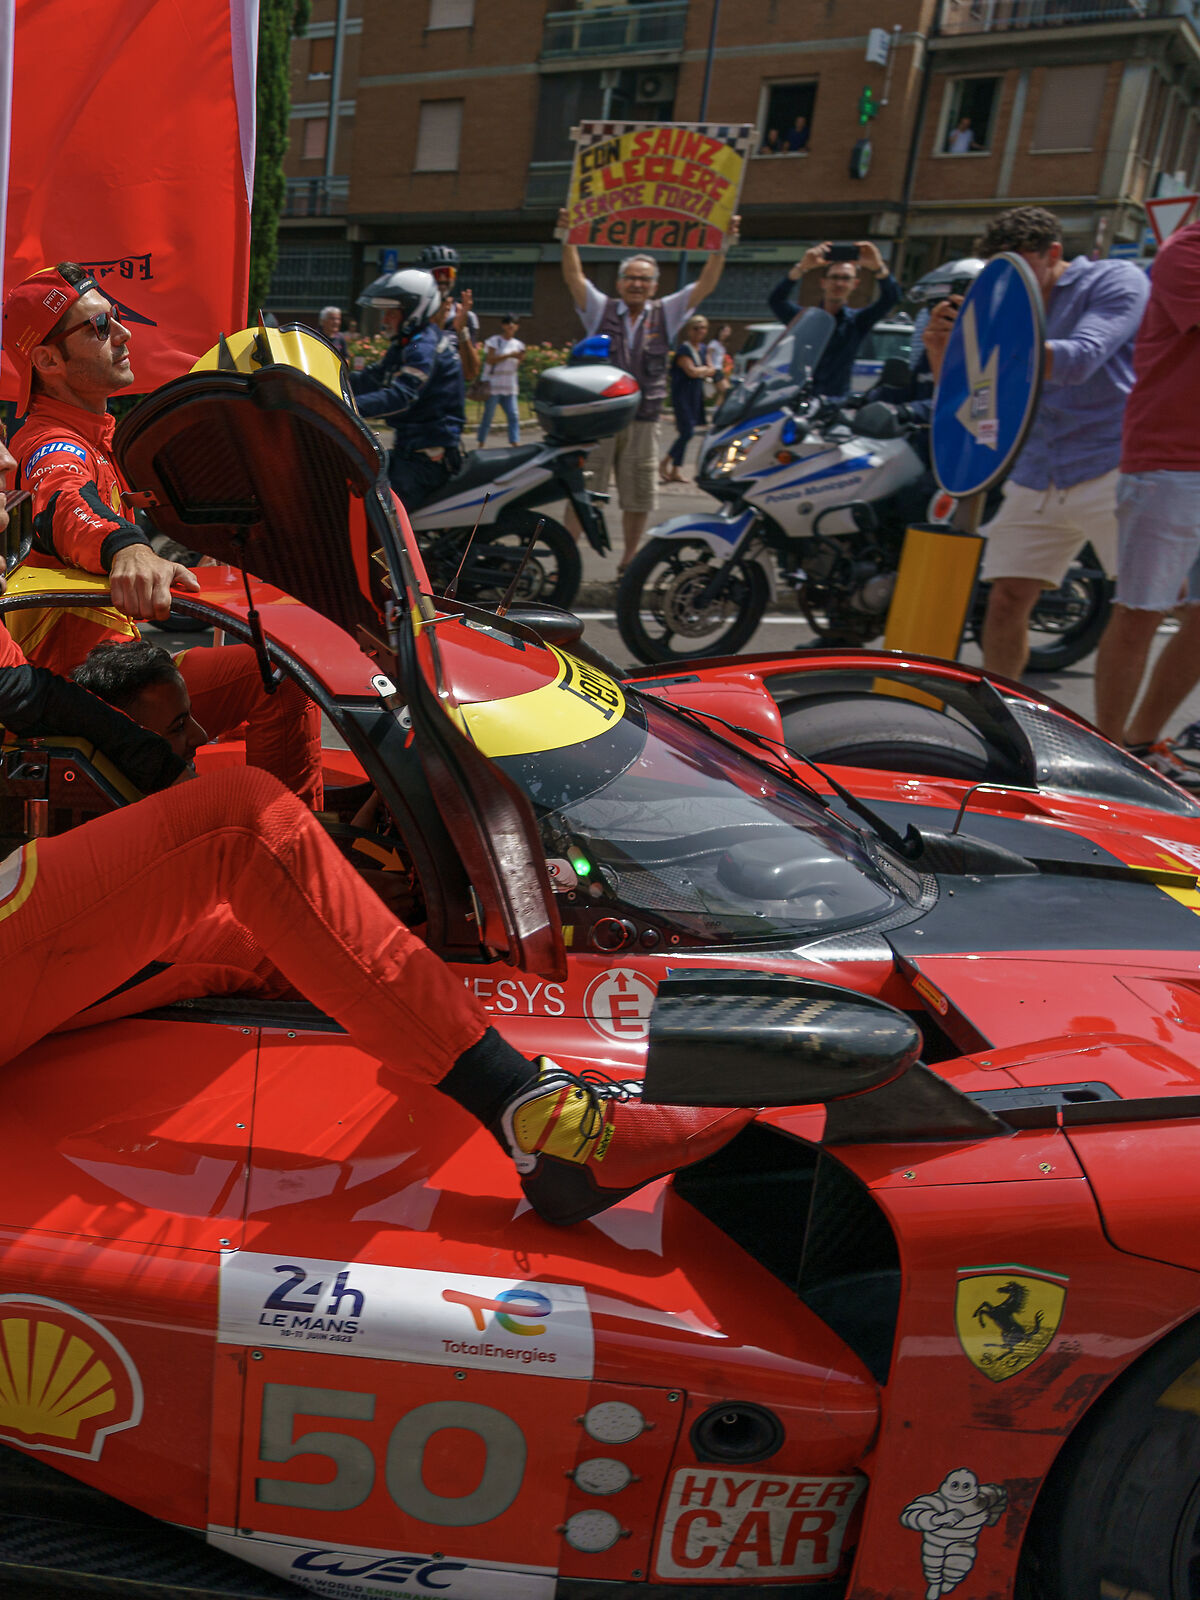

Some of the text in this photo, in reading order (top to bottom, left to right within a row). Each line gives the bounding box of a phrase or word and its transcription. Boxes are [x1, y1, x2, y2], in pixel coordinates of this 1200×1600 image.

[580, 128, 724, 174] CON SAINZ
[579, 175, 592, 200] E
[654, 184, 716, 220] FORZA
[588, 216, 707, 248] Ferrari
[465, 977, 565, 1016] ESYS
[258, 1313, 359, 1334] LE MANS
[329, 1333, 353, 1343] 2023
[442, 1339, 557, 1364] TotalEnergies
[255, 1382, 528, 1527] 50
[680, 1475, 855, 1508] HYPER
[671, 1508, 837, 1569] CAR
[314, 1579, 364, 1592] WORLD
